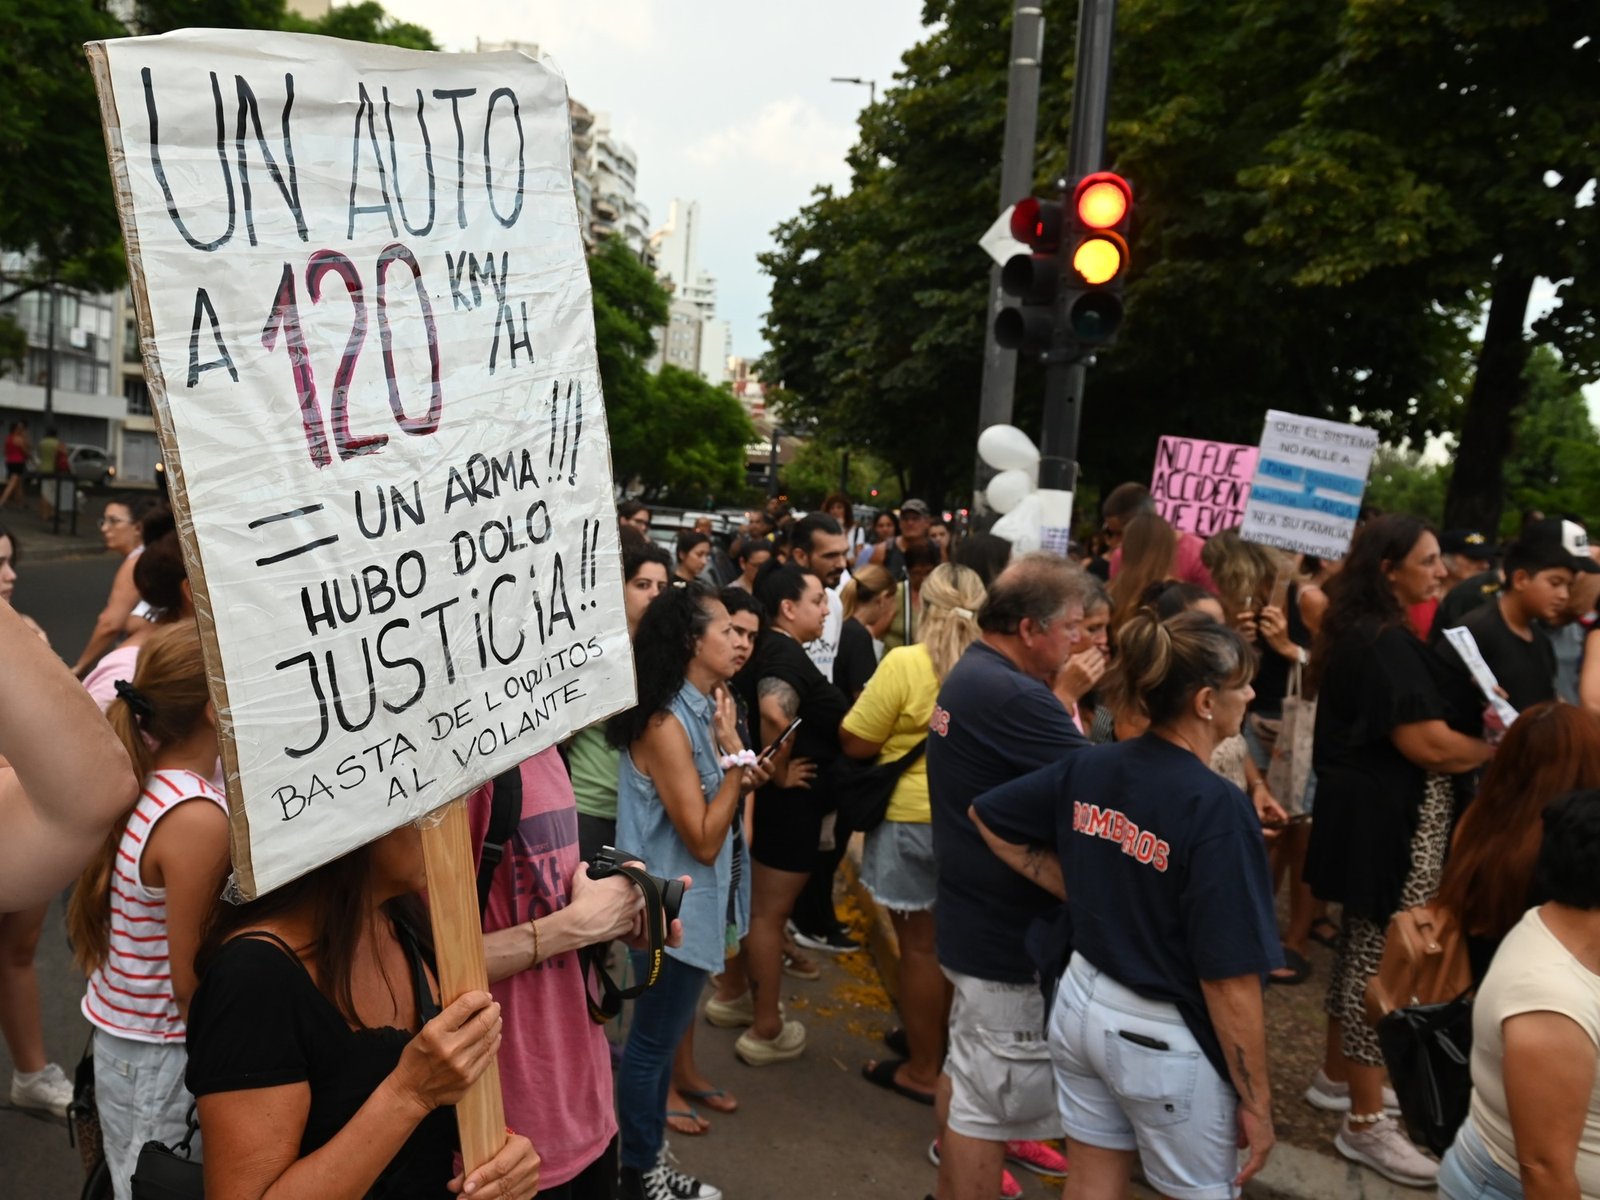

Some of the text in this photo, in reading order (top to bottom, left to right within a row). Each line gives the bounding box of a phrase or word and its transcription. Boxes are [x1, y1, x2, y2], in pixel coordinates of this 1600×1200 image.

[141, 67, 525, 252] UN AUTO
[187, 287, 240, 388] A
[260, 242, 443, 470] 120
[354, 480, 426, 540] UN
[1159, 439, 1248, 478] NO FUE
[1280, 441, 1299, 455] NO
[300, 500, 552, 636] HUBO DOLO
[271, 733, 418, 822] BASTA
[428, 698, 474, 742] DE
[387, 678, 587, 807] AL VOLANTE
[1072, 800, 1170, 872] BOMBROS
